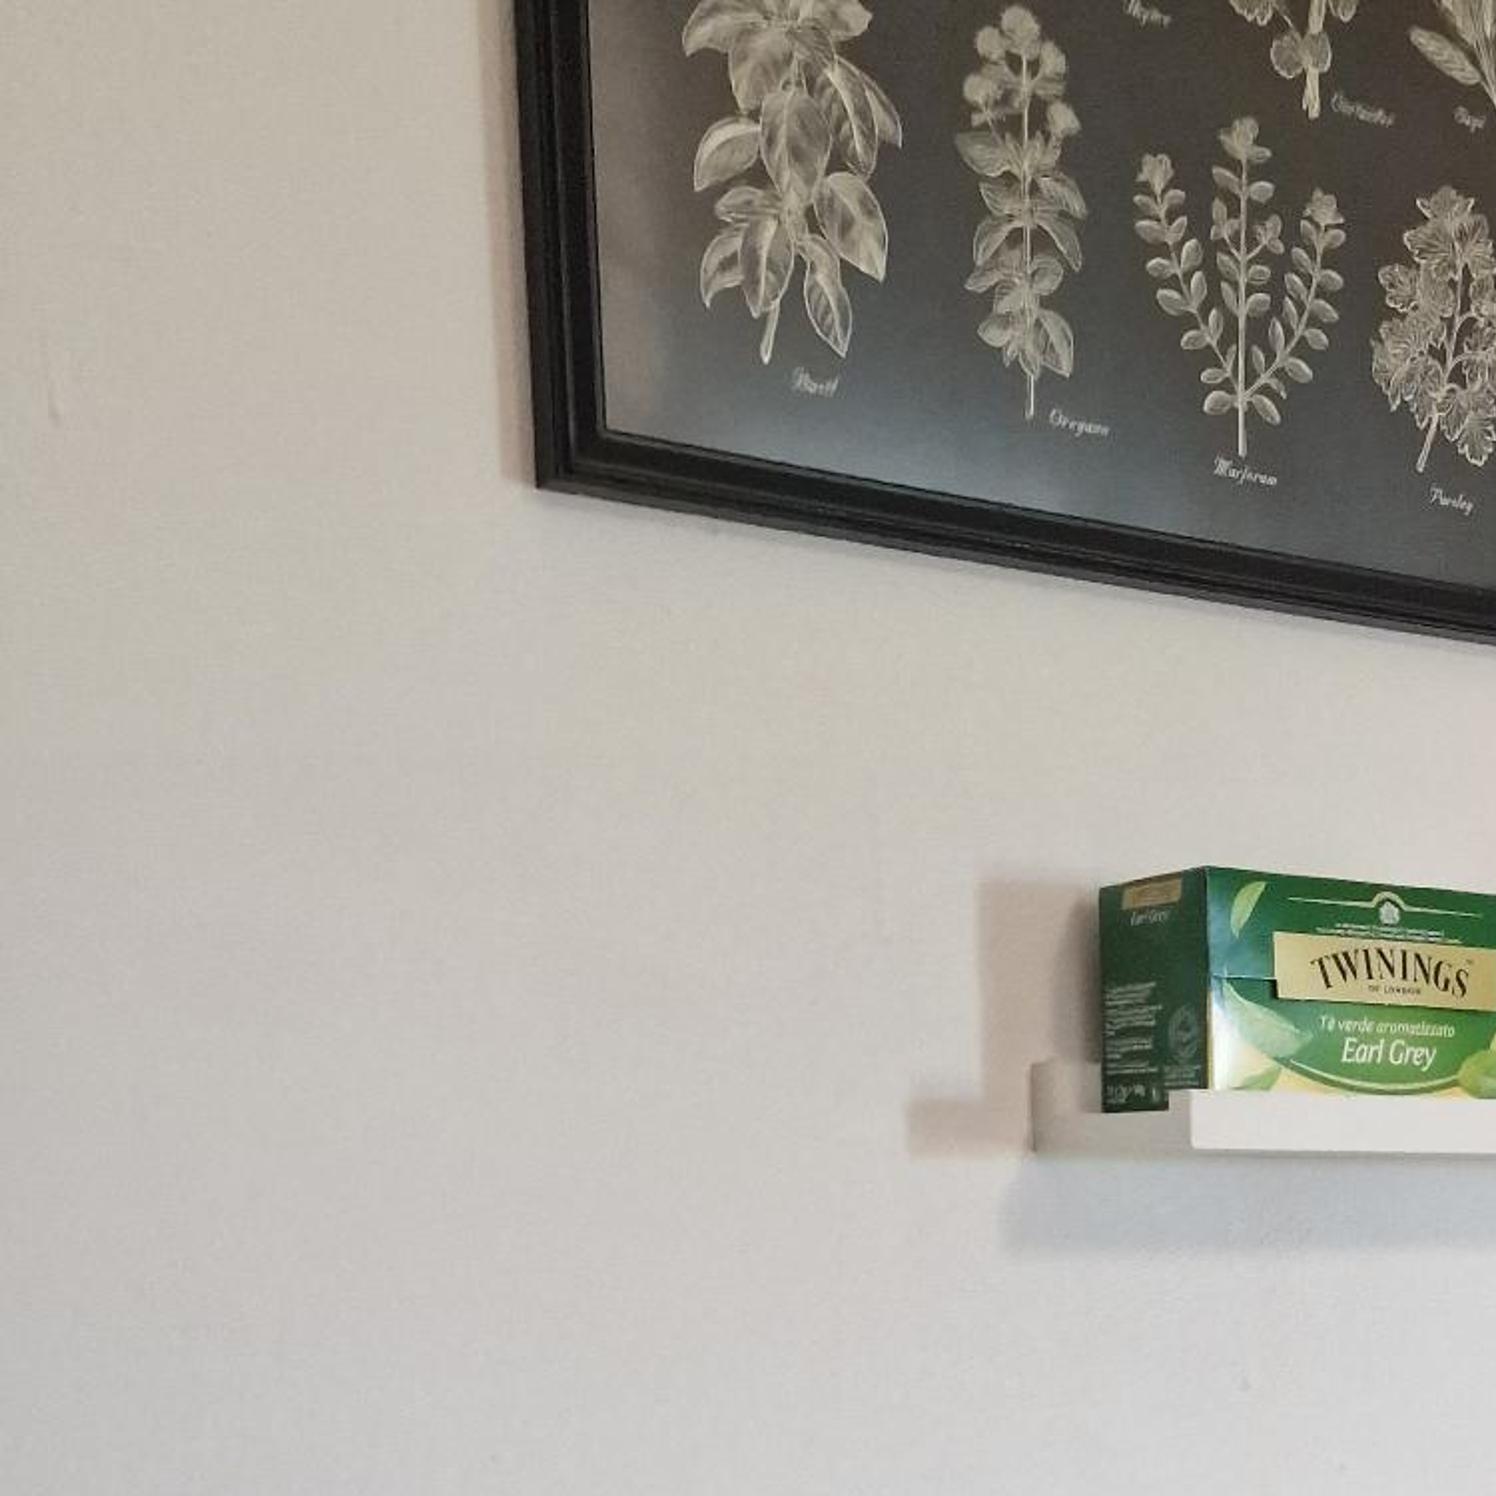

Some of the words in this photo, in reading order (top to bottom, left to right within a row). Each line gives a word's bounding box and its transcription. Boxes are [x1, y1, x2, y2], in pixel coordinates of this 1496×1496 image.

[1310, 946, 1469, 998] TWININGS
[1337, 1017, 1373, 1034] verde
[1376, 1021, 1456, 1038] aromatizzato
[1341, 1036, 1385, 1064] Earl
[1388, 1038, 1437, 1072] Grey
